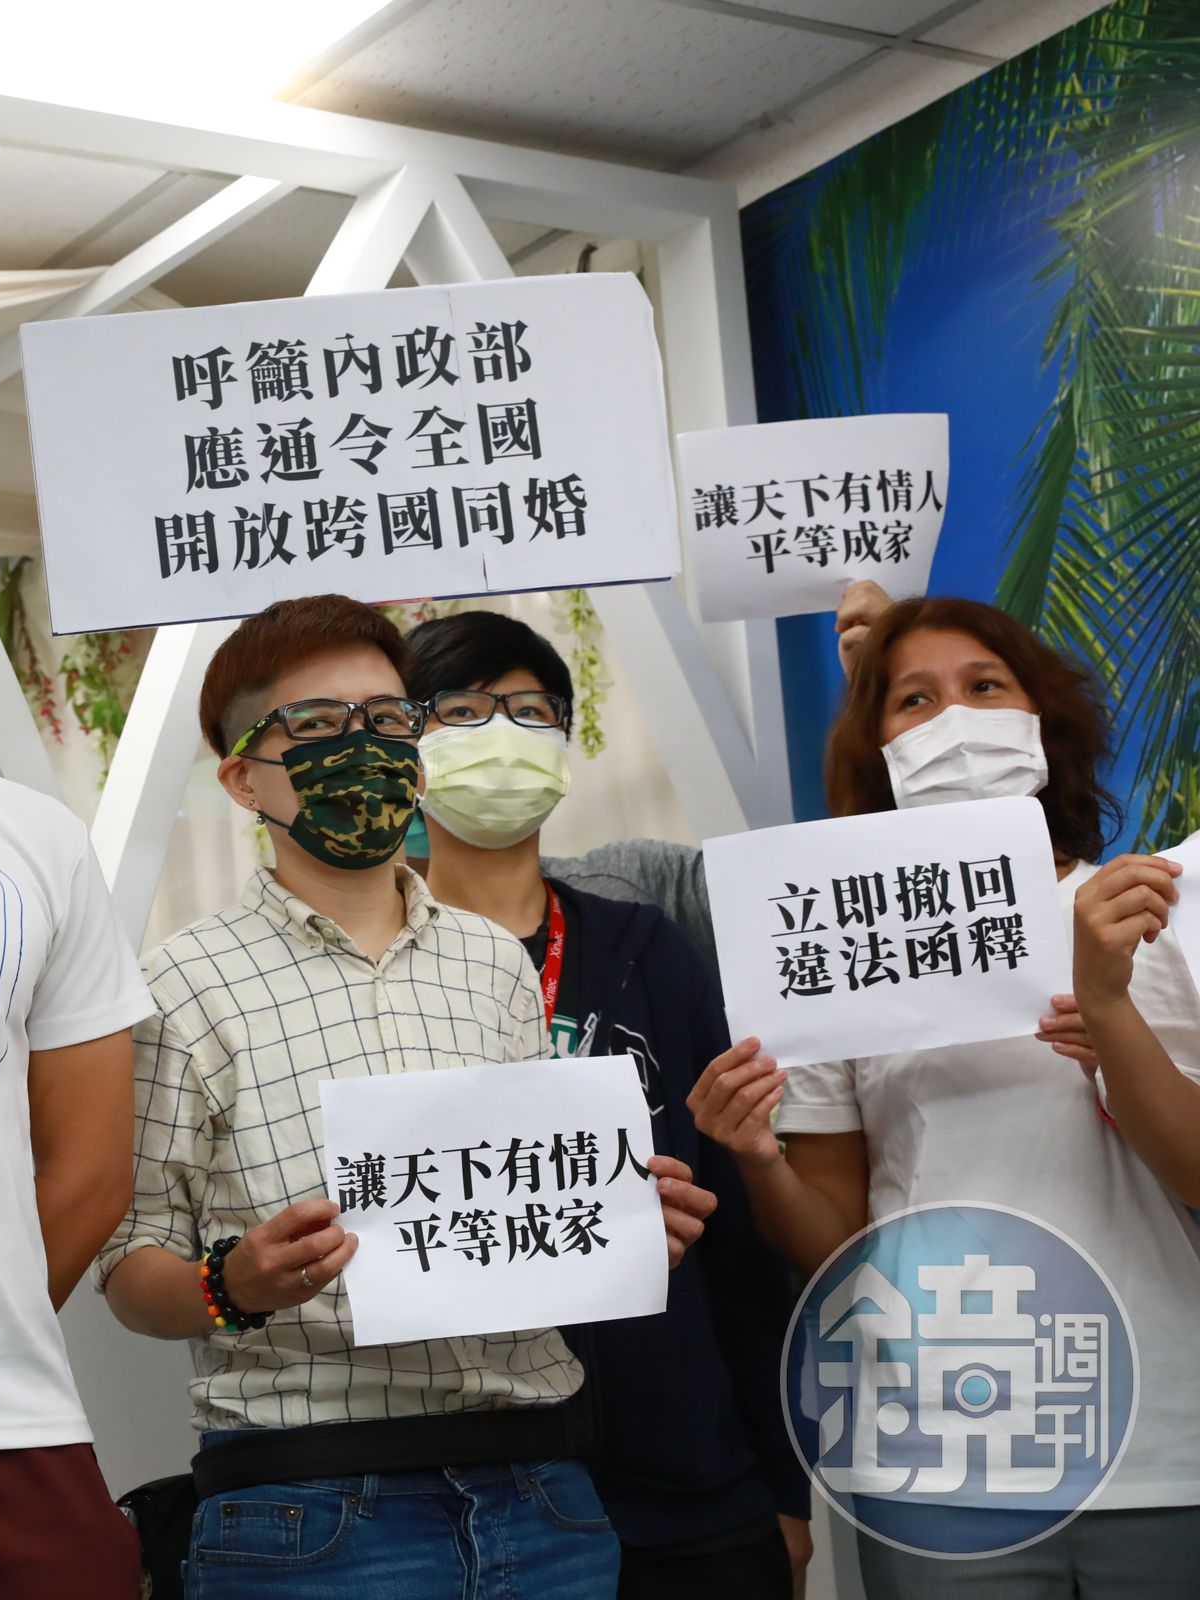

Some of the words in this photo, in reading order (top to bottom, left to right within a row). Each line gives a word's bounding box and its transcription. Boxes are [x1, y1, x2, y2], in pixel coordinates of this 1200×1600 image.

[172, 319, 533, 410] 呼籲內政部
[184, 397, 542, 495] 應通令全國
[154, 472, 588, 579] 開放跨國同婚
[691, 469, 944, 532] 讓天下有情人
[746, 519, 914, 574] 平等成家
[768, 853, 1018, 937] 立即撤回
[543, 977, 558, 1008] Xintec
[775, 912, 1030, 1000] 違法函釋
[333, 1127, 651, 1215] 讓天下有情人
[394, 1198, 610, 1273] 平等成家
